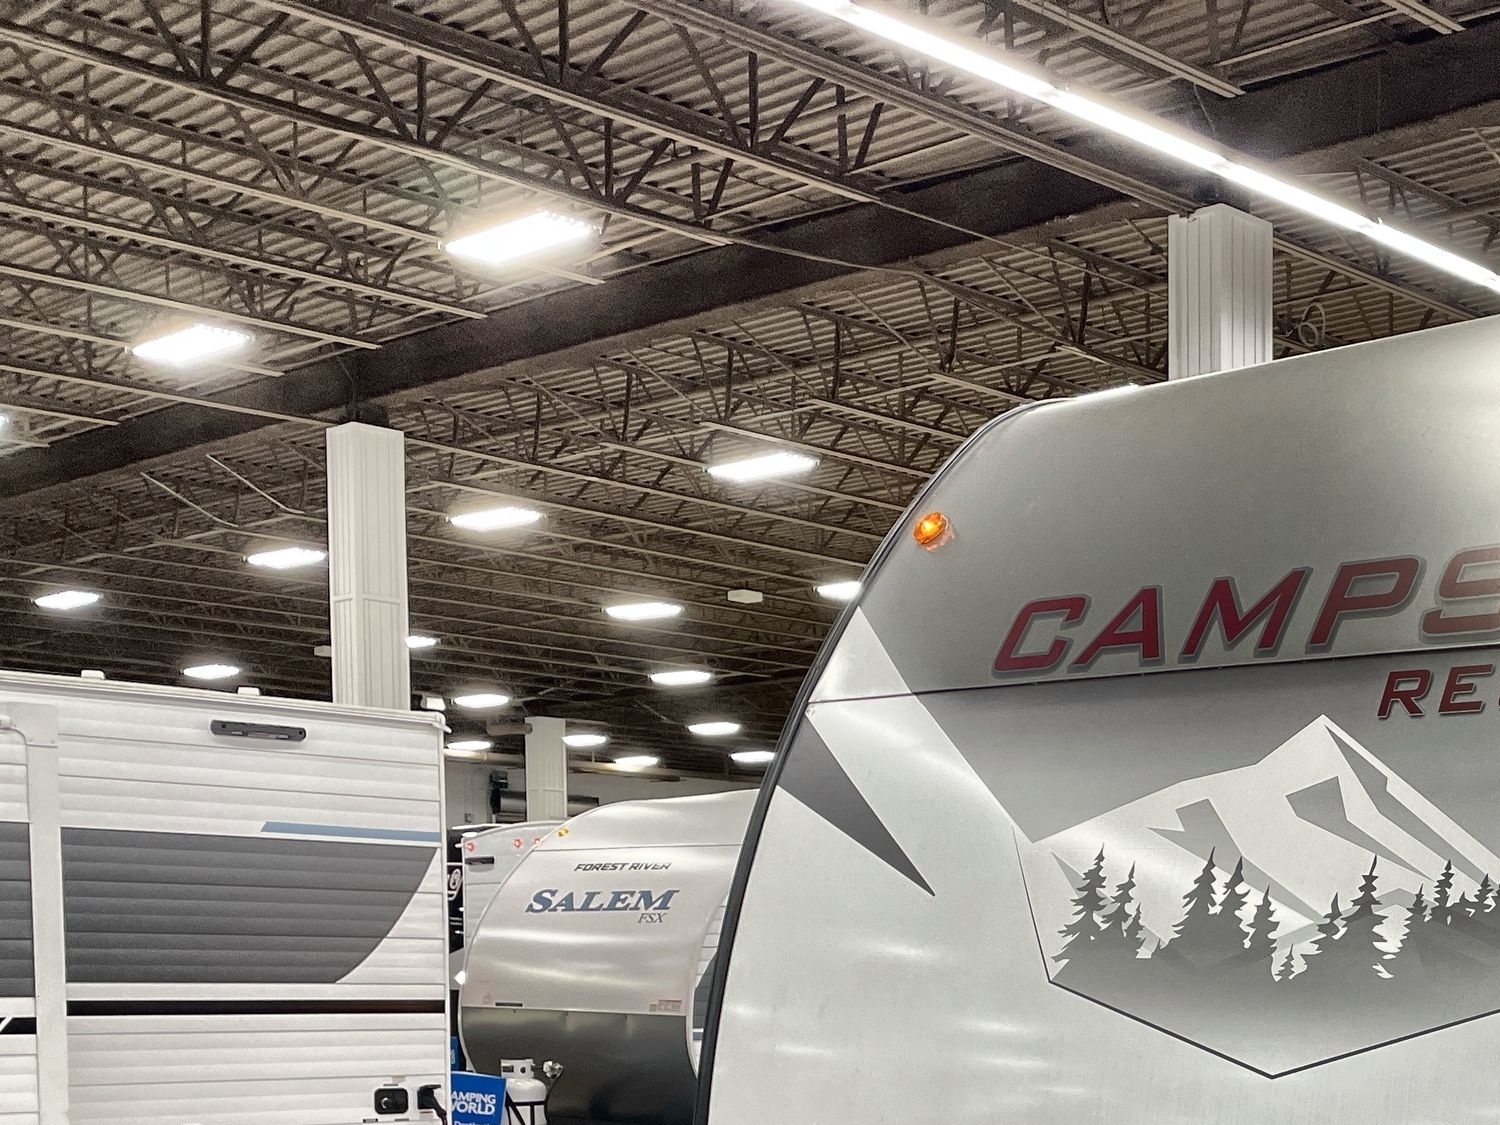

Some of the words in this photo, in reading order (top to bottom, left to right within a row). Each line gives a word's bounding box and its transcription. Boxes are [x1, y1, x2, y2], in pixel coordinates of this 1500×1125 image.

[574, 863, 629, 872] FOREST
[525, 889, 680, 913] SALEM
[637, 912, 668, 924] FSX
[451, 1091, 496, 1105] AMPING
